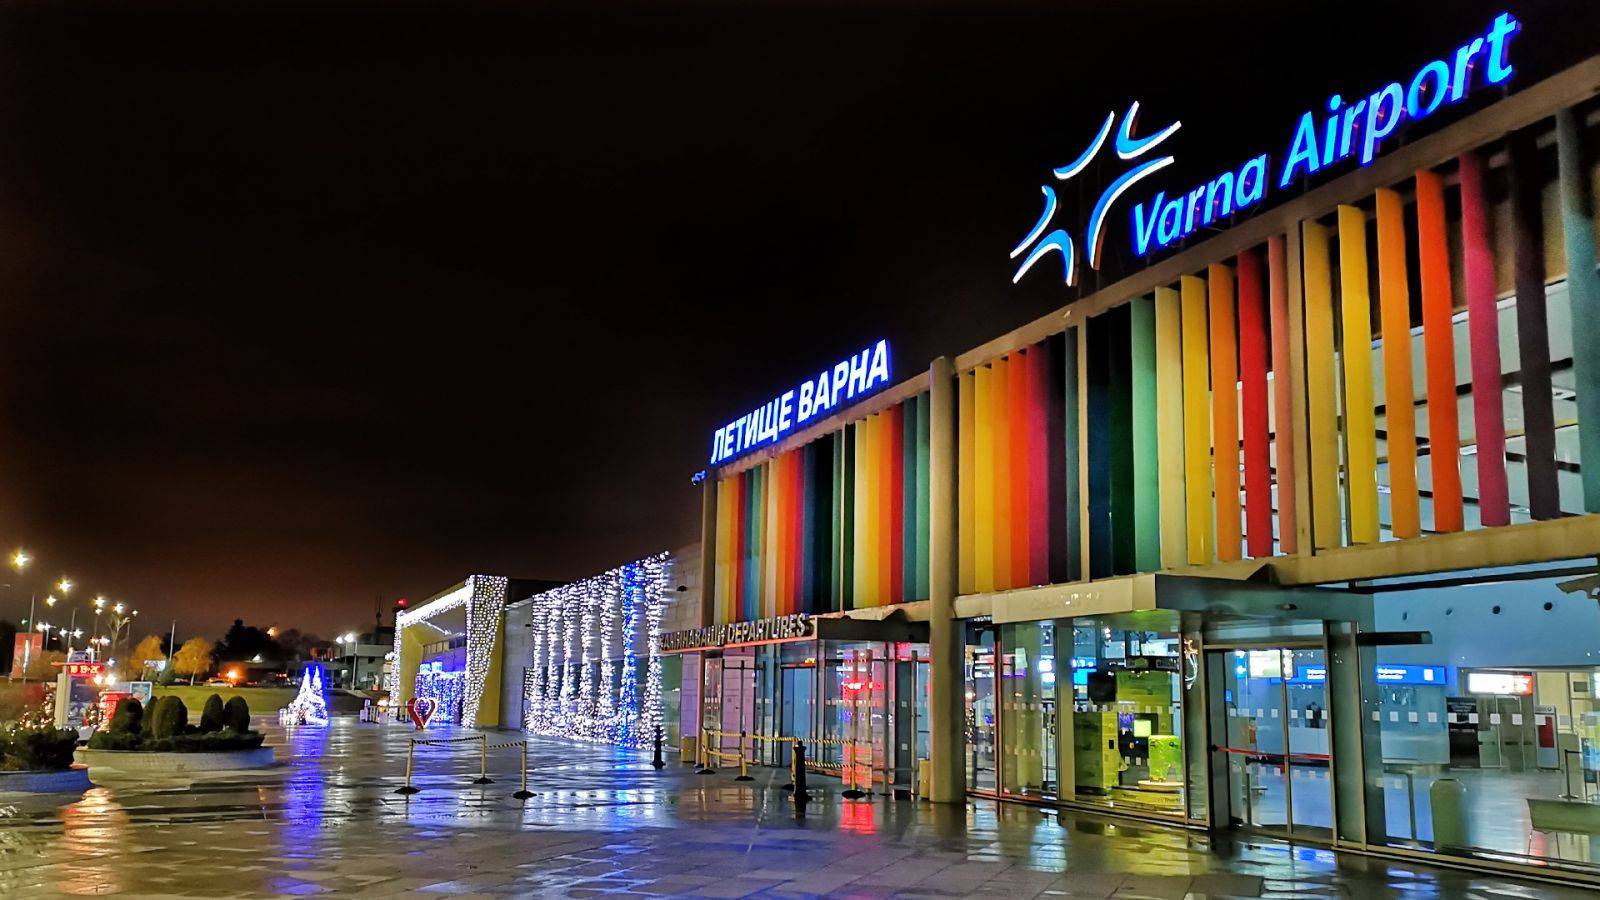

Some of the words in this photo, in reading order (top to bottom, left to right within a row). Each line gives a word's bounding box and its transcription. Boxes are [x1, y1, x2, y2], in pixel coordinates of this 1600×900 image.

[1131, 153, 1268, 256] Varna
[1279, 12, 1518, 188] Airport
[710, 389, 794, 465] ЛЕТИЩЕ
[797, 339, 889, 424] ВАРНА
[727, 613, 806, 645] DEPARTURES
